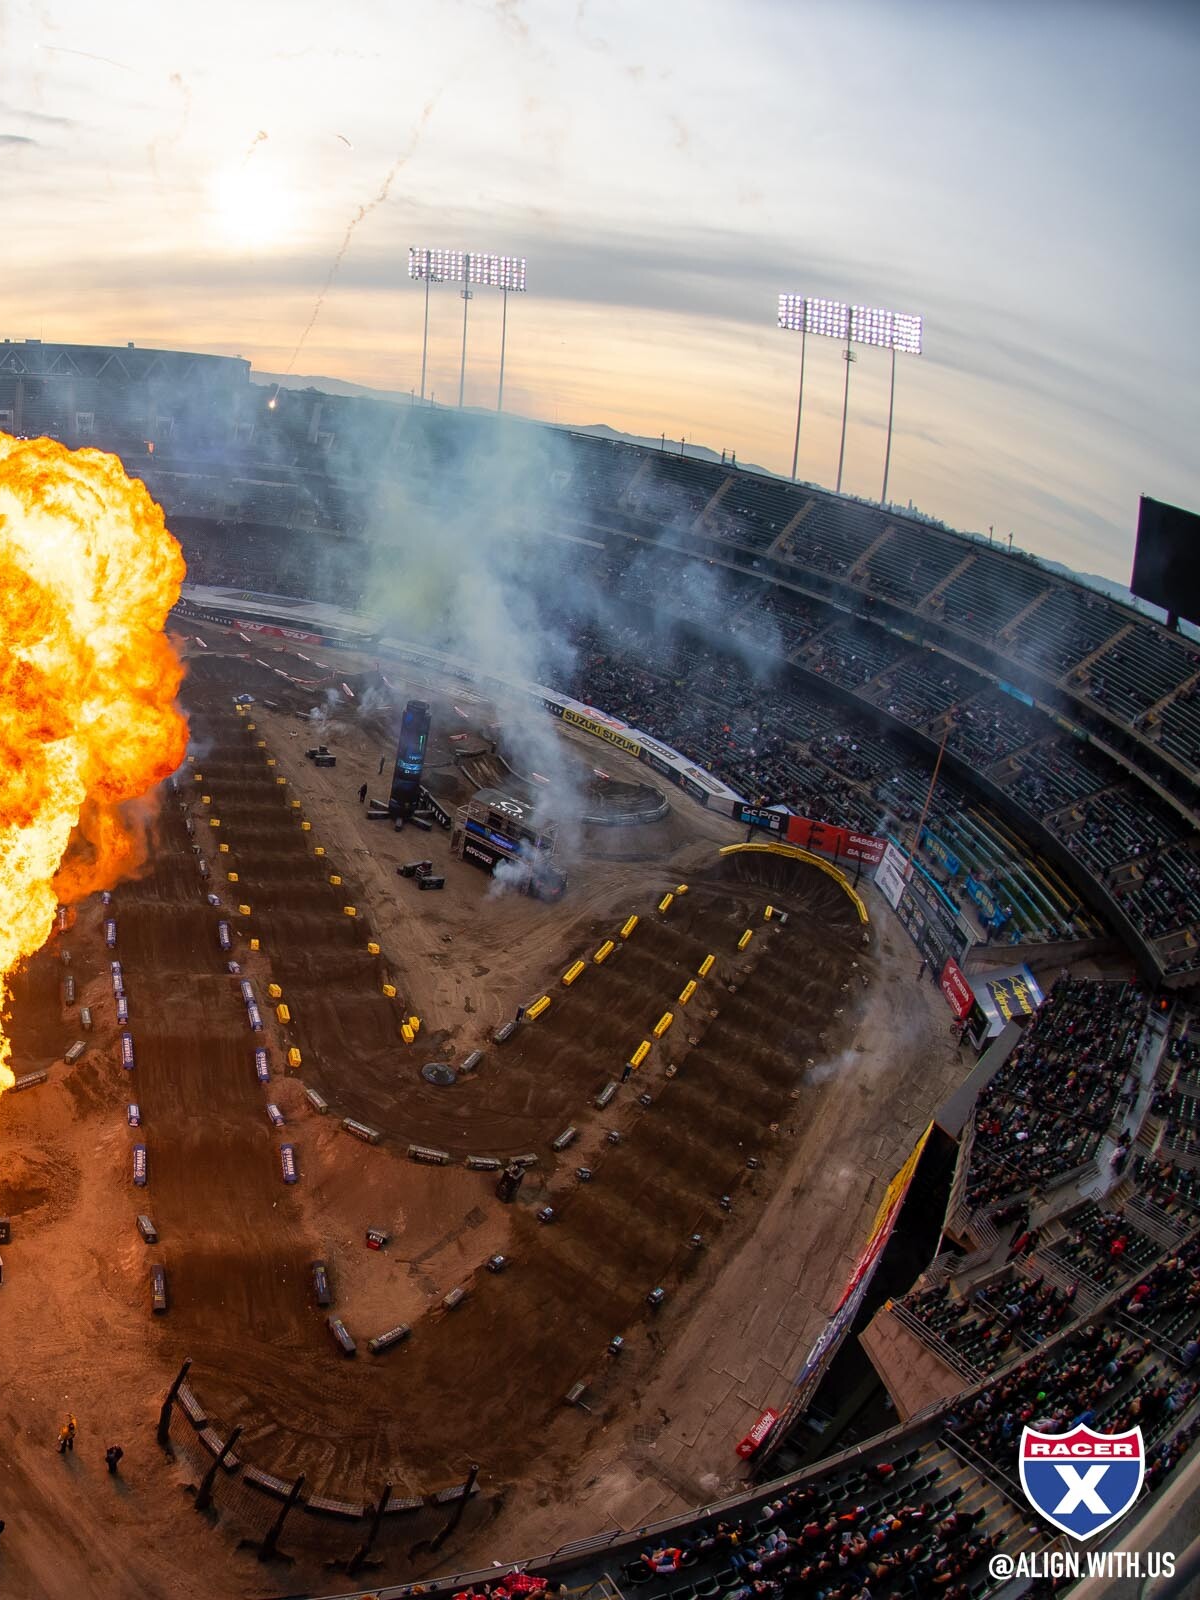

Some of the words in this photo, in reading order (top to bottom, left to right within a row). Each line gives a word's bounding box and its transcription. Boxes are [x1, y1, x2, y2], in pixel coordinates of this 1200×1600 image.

[565, 711, 601, 735] SUZUKI
[602, 729, 640, 756] SUZUKI
[490, 802, 525, 819] OAKLEY
[849, 835, 884, 850] GASGAS
[947, 987, 963, 1016] HONDA
[953, 973, 969, 1002] HONDA
